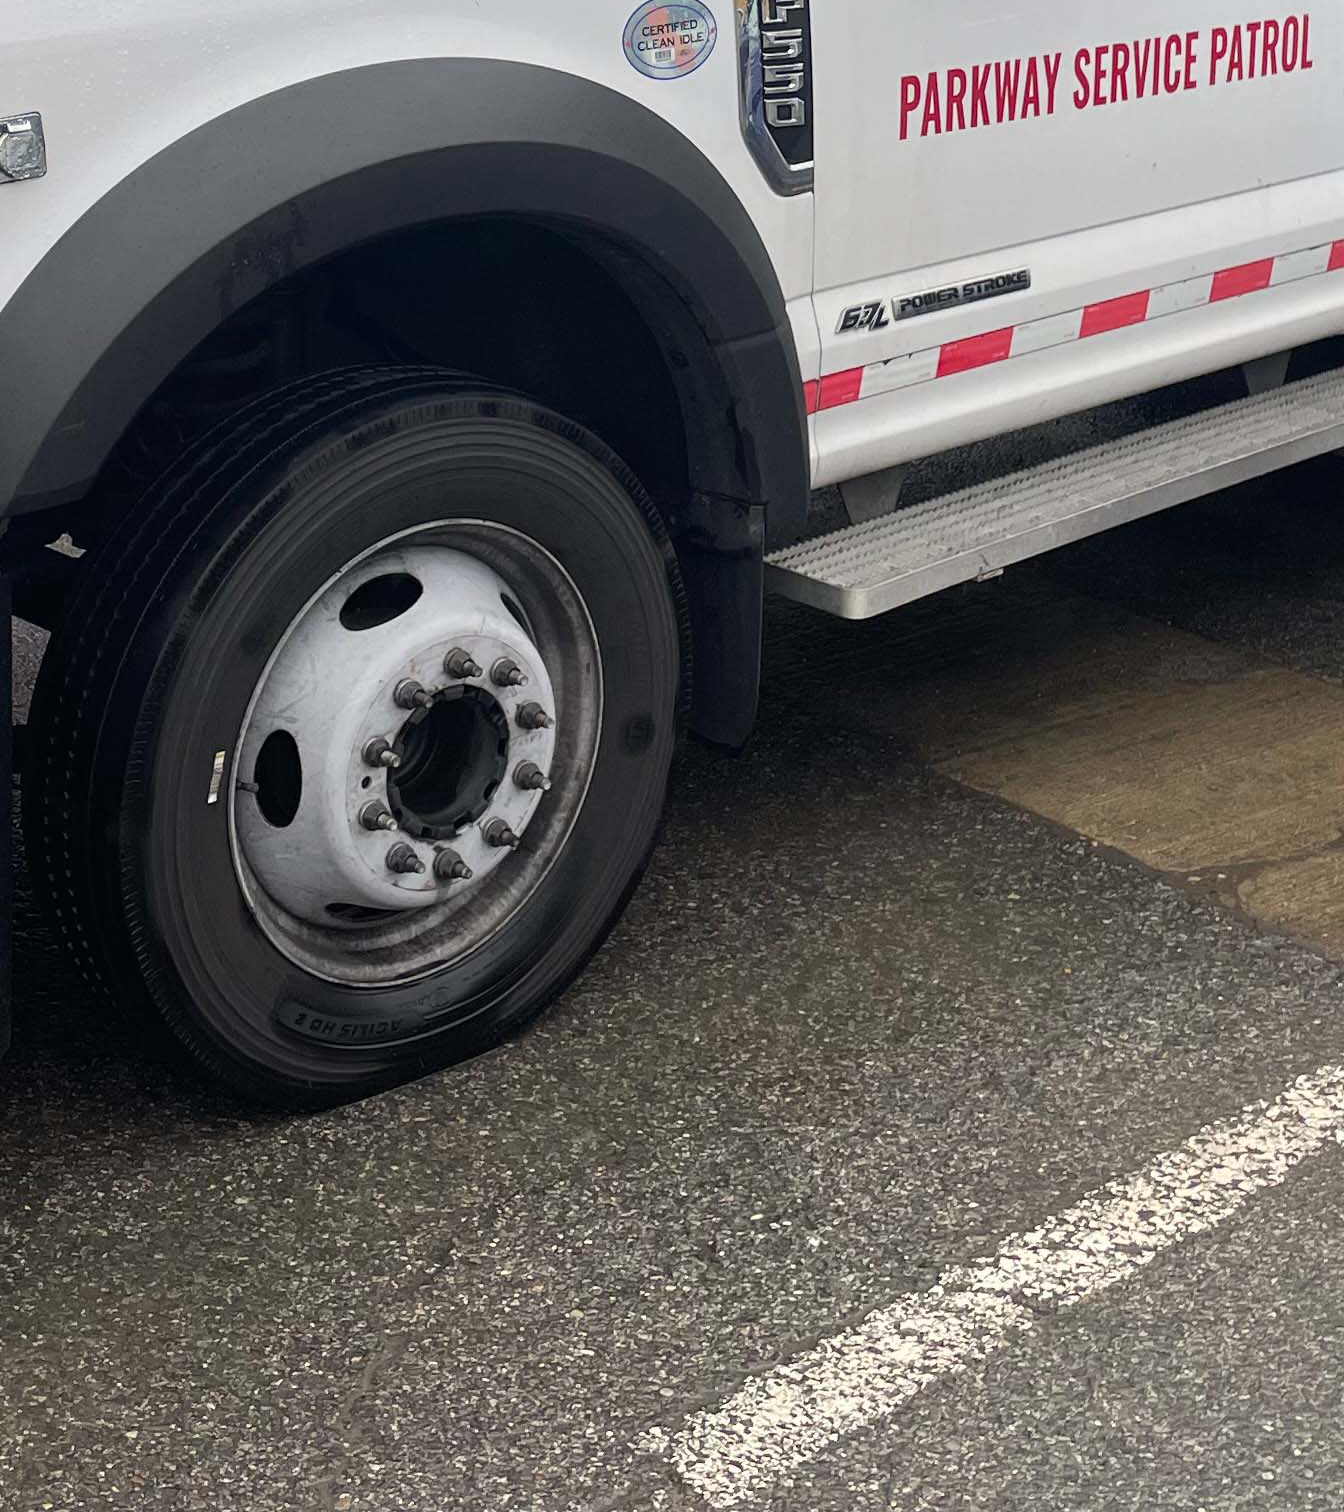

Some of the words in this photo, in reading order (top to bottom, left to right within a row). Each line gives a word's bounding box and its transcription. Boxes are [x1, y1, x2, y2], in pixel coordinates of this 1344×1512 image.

[637, 37, 675, 52] CLEAN
[679, 31, 706, 46] IDLE
[641, 18, 698, 38] CERTIFIED
[898, 52, 1062, 141] PARKWAY
[1073, 30, 1199, 110] SERVICE
[1208, 13, 1313, 86] PATROL
[898, 289, 960, 313] POWER
[962, 268, 1027, 298] STROKE
